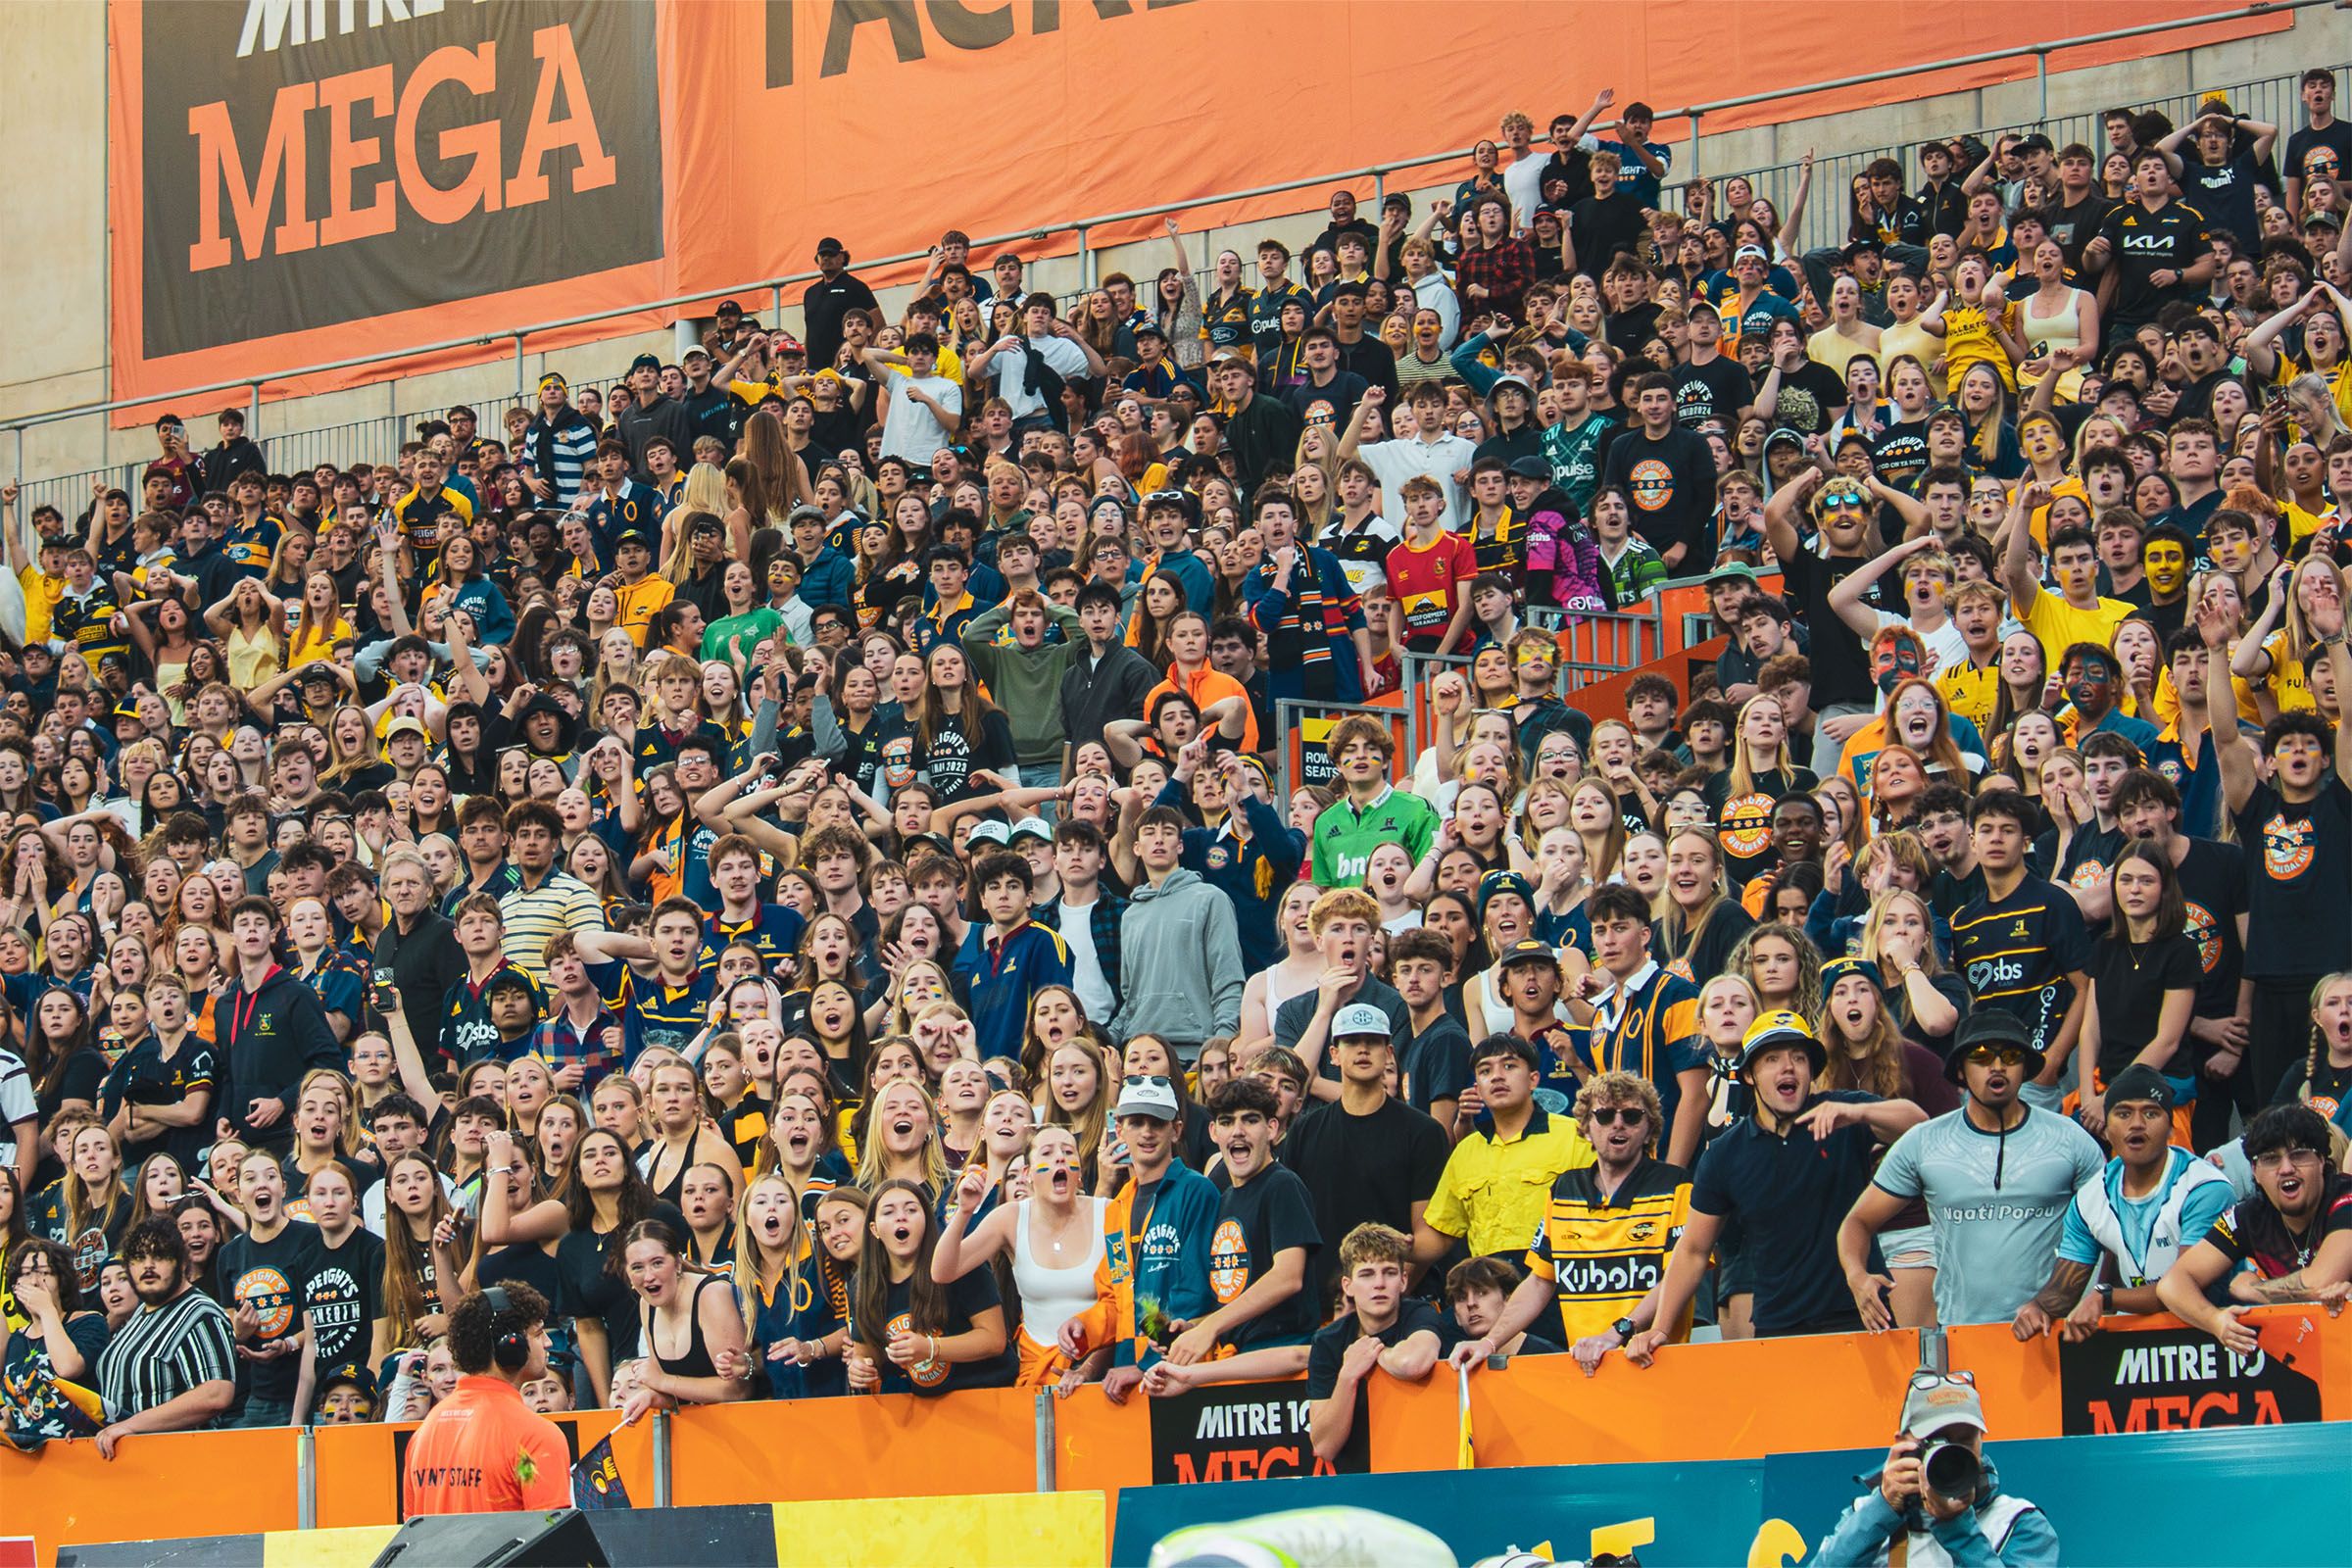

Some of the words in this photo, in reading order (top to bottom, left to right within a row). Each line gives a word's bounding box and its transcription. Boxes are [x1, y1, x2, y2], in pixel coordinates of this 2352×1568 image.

[189, 24, 616, 272] MEGA
[1556, 461, 1594, 481] pulse
[946, 761, 968, 774] 2023
[1337, 853, 1370, 879] bn
[1993, 956, 2023, 983] sbs
[472, 1018, 499, 1042] sbs
[1943, 1205, 1994, 1227] Ngati
[1998, 1203, 2055, 1224] Porou
[236, 1271, 286, 1297] SPEIGHT'S
[1553, 1256, 1658, 1293] Kubota
[2115, 1345, 2218, 1383] MITRE
[1196, 1403, 1282, 1439] MITRE
